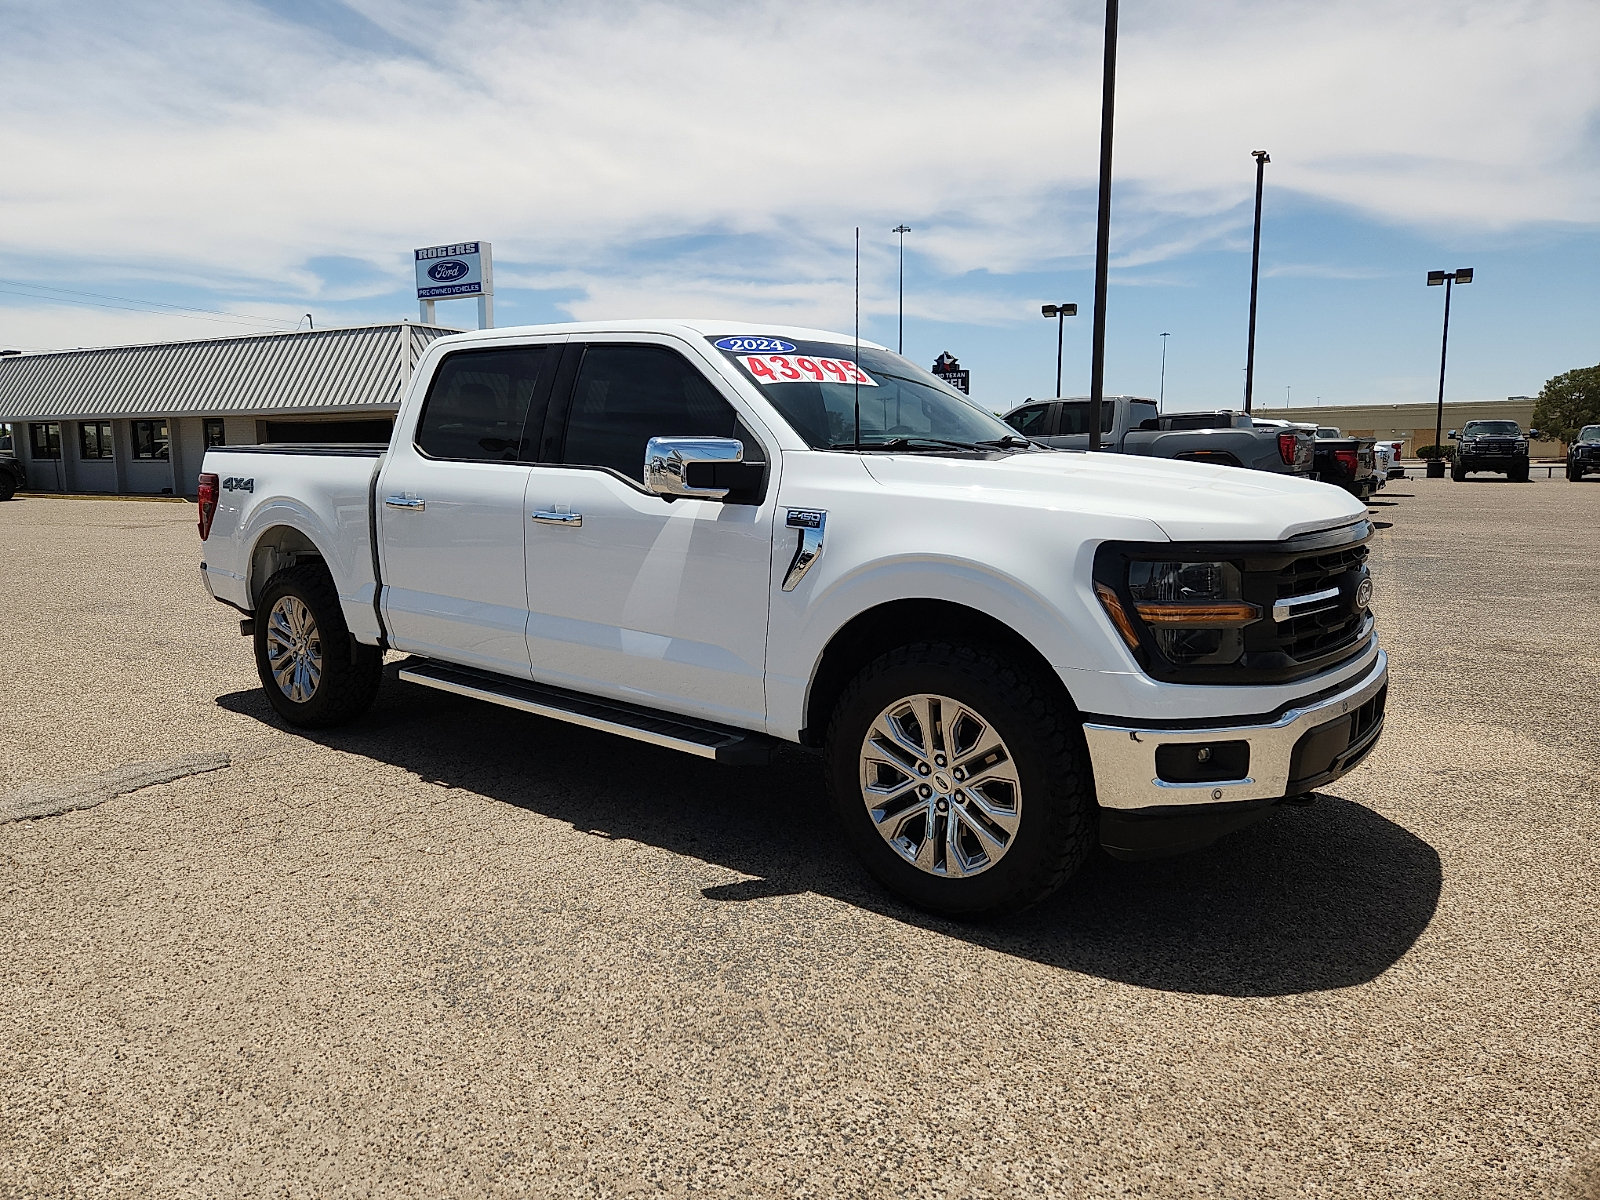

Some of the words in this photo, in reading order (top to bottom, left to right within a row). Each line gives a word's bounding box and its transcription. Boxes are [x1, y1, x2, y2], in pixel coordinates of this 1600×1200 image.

[418, 243, 476, 260] ROGERS
[435, 263, 460, 279] Ford
[418, 287, 452, 296] PRE-OWNED
[452, 284, 479, 293] VEHICLES
[729, 339, 785, 351] 2024
[747, 355, 868, 382] 43995
